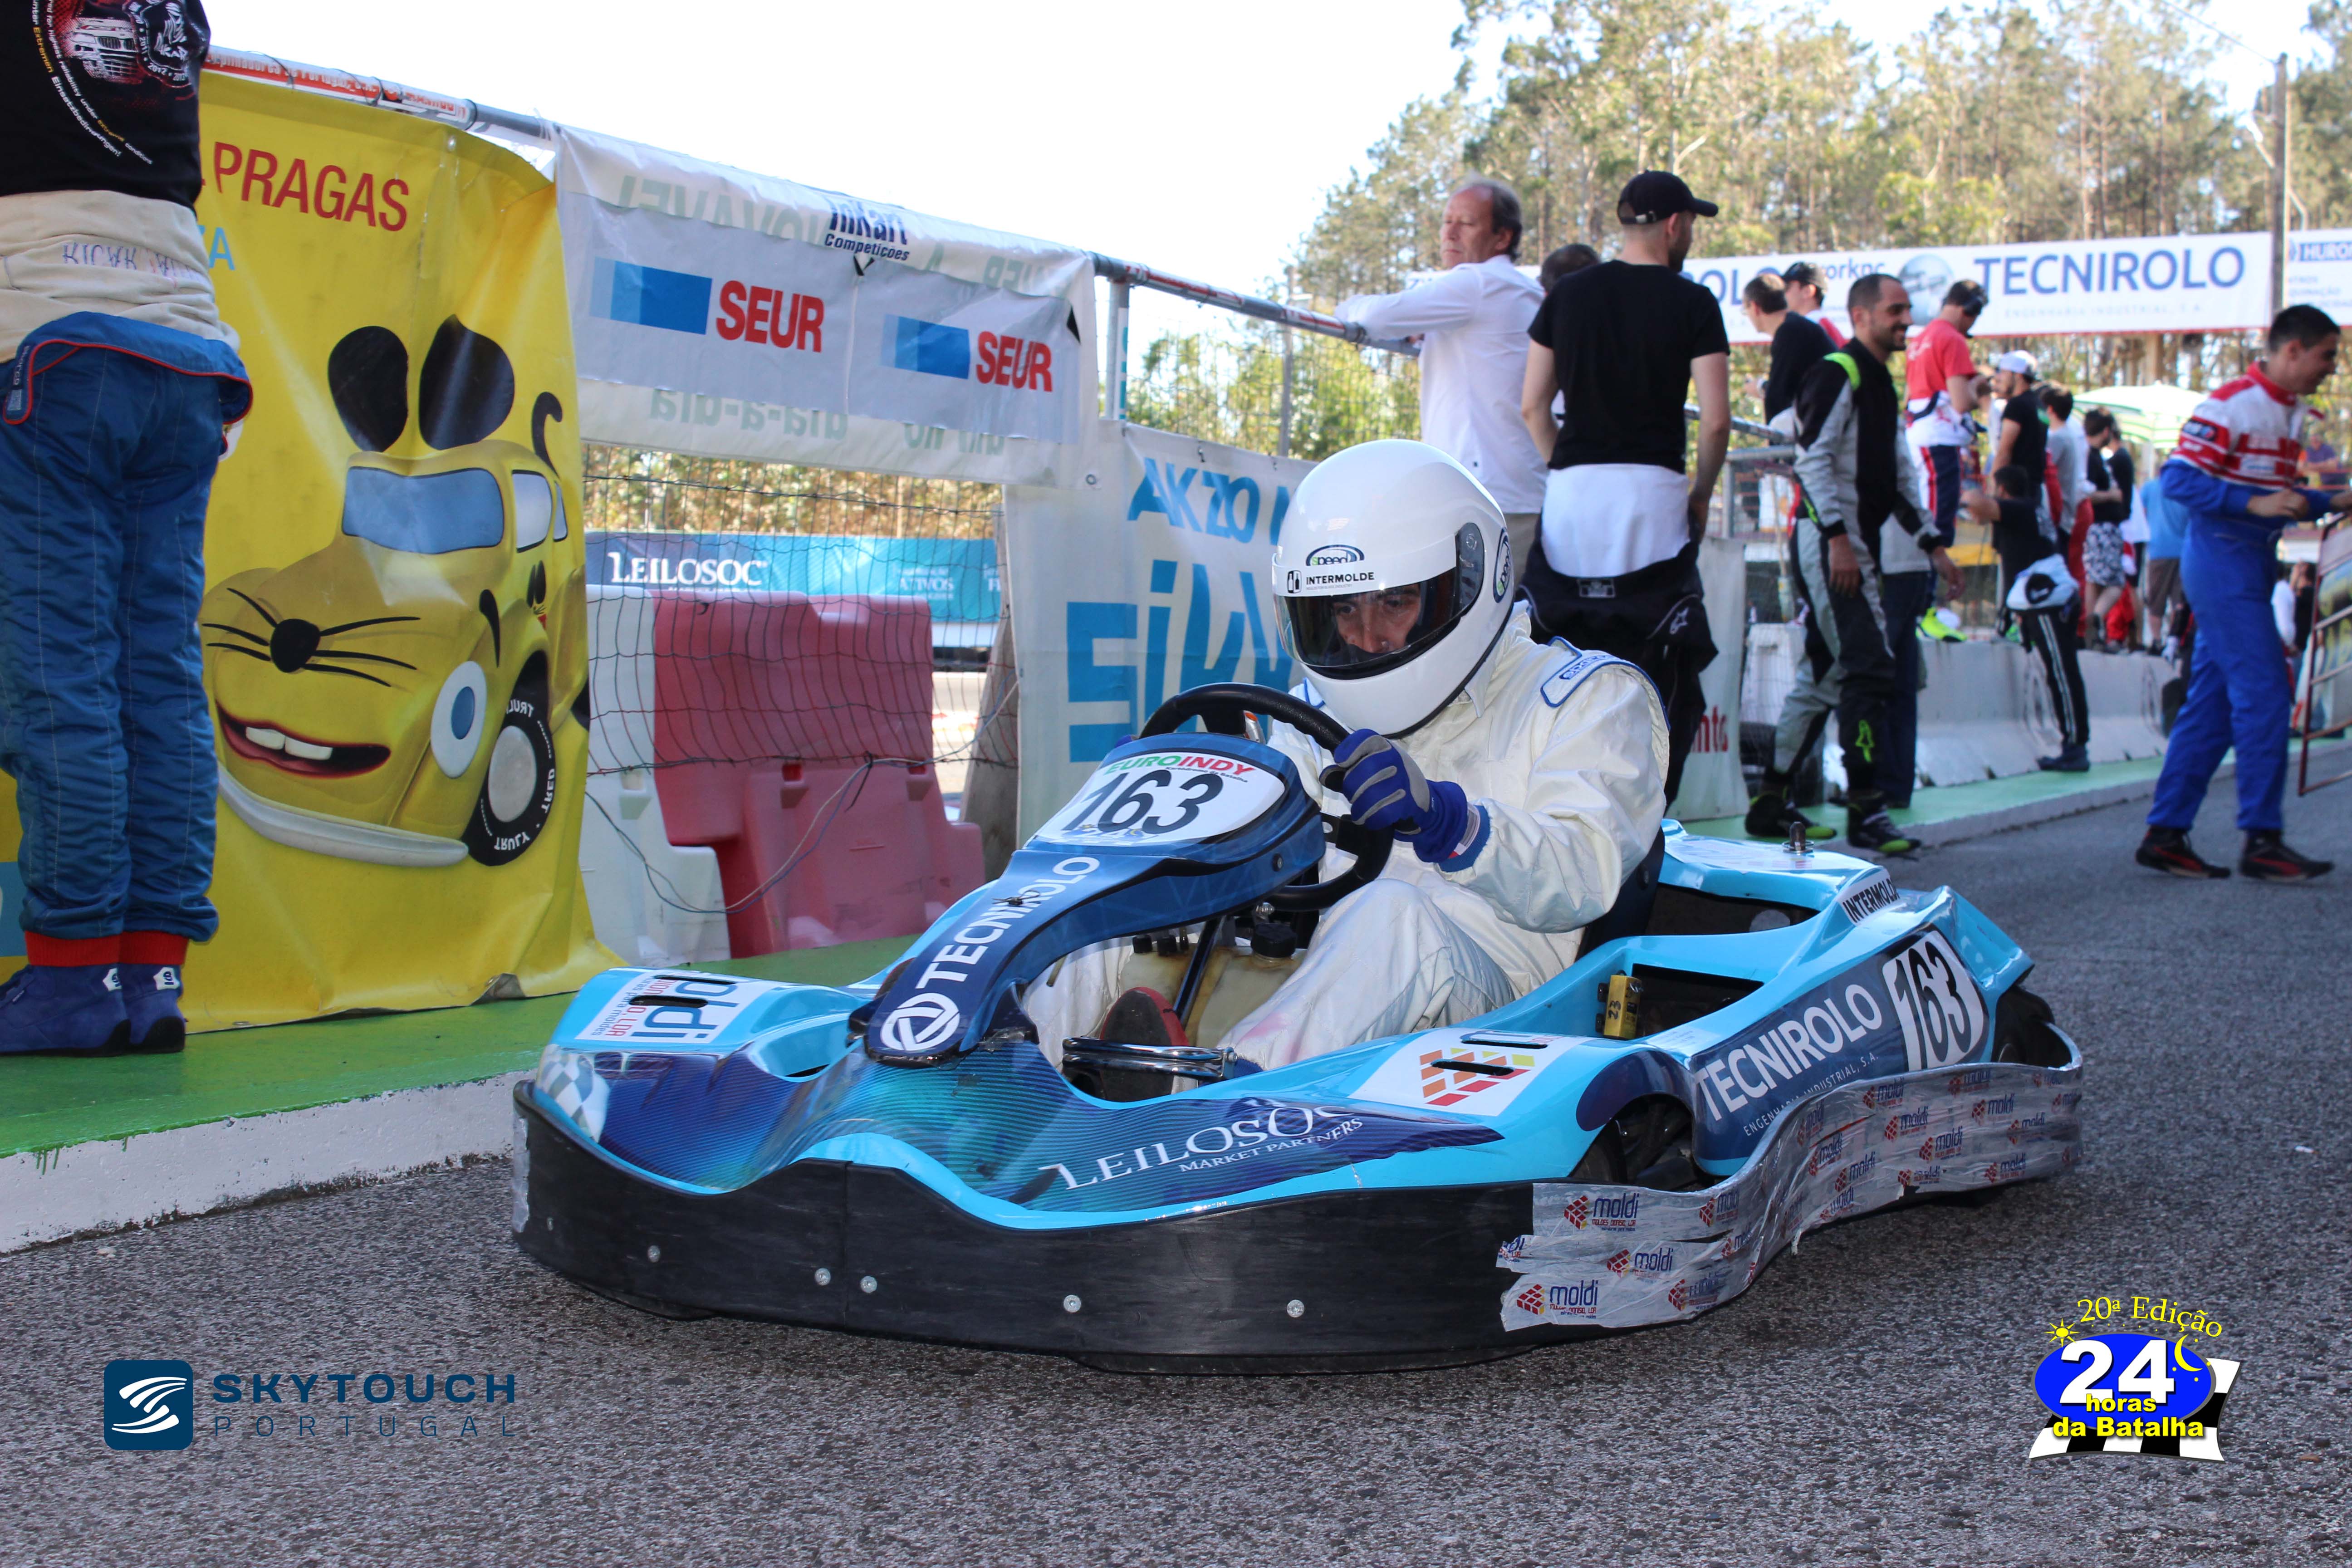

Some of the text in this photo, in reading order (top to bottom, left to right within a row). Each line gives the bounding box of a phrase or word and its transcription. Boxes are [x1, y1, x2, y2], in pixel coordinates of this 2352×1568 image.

[33, 27, 54, 73] Extremen
[80, 98, 98, 119] under
[125, 142, 153, 164] conditions
[213, 142, 410, 231] PRAGAS
[1974, 245, 2245, 296] TECNIROLO
[715, 280, 825, 353] SEUR
[975, 331, 1053, 392] SEUR
[1127, 457, 1260, 544] AKZO
[607, 551, 763, 586] LEILOSOC
[1306, 572, 1375, 585] INTERMOLDE
[1103, 755, 1255, 776] EUROINDY
[1059, 769, 1224, 835] 163
[590, 1008, 620, 1036] moldes
[1894, 941, 1973, 1072] 163
[1693, 983, 1883, 1122] TECNIROLO
[1987, 1092, 2015, 1115] moldi
[1038, 1105, 1355, 1191] LEILOSOC
[1178, 1117, 1364, 1172] MARKET PARTNERS
[1935, 1125, 1963, 1151] moldi
[1849, 1151, 1876, 1181] moldi
[1593, 1192, 1640, 1219] moldi
[1634, 1248, 1674, 1271] moldi
[1549, 1279, 1599, 1306] moldi
